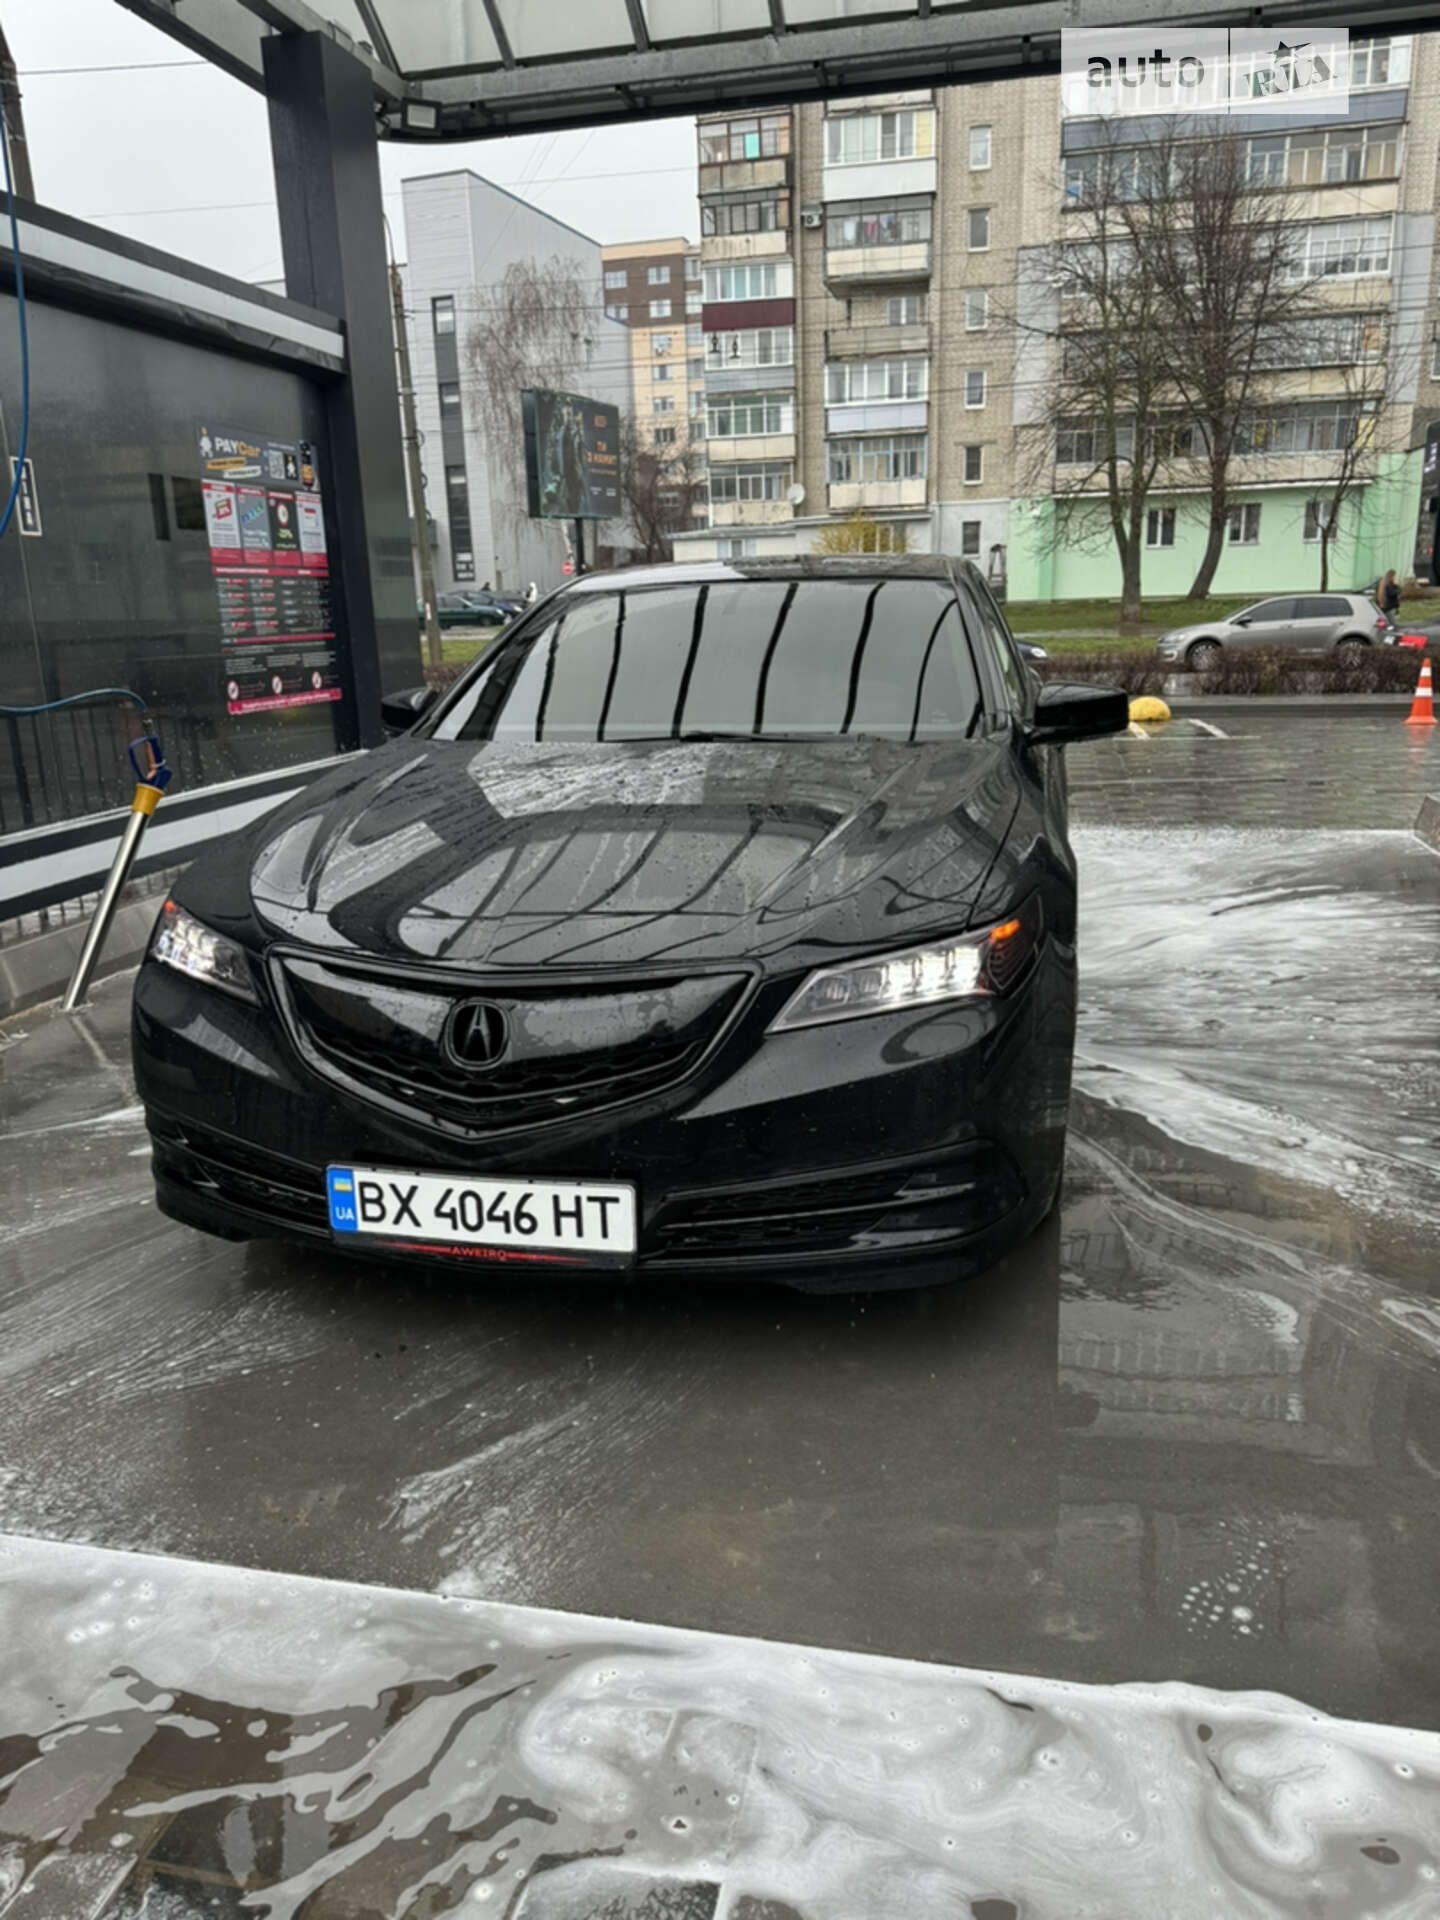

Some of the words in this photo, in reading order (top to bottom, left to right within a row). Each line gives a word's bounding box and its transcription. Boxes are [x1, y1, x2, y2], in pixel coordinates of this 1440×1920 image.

[335, 1206, 355, 1221] UA
[358, 1181, 421, 1228] BX
[434, 1188, 538, 1236] 4046
[551, 1194, 620, 1240] HT
